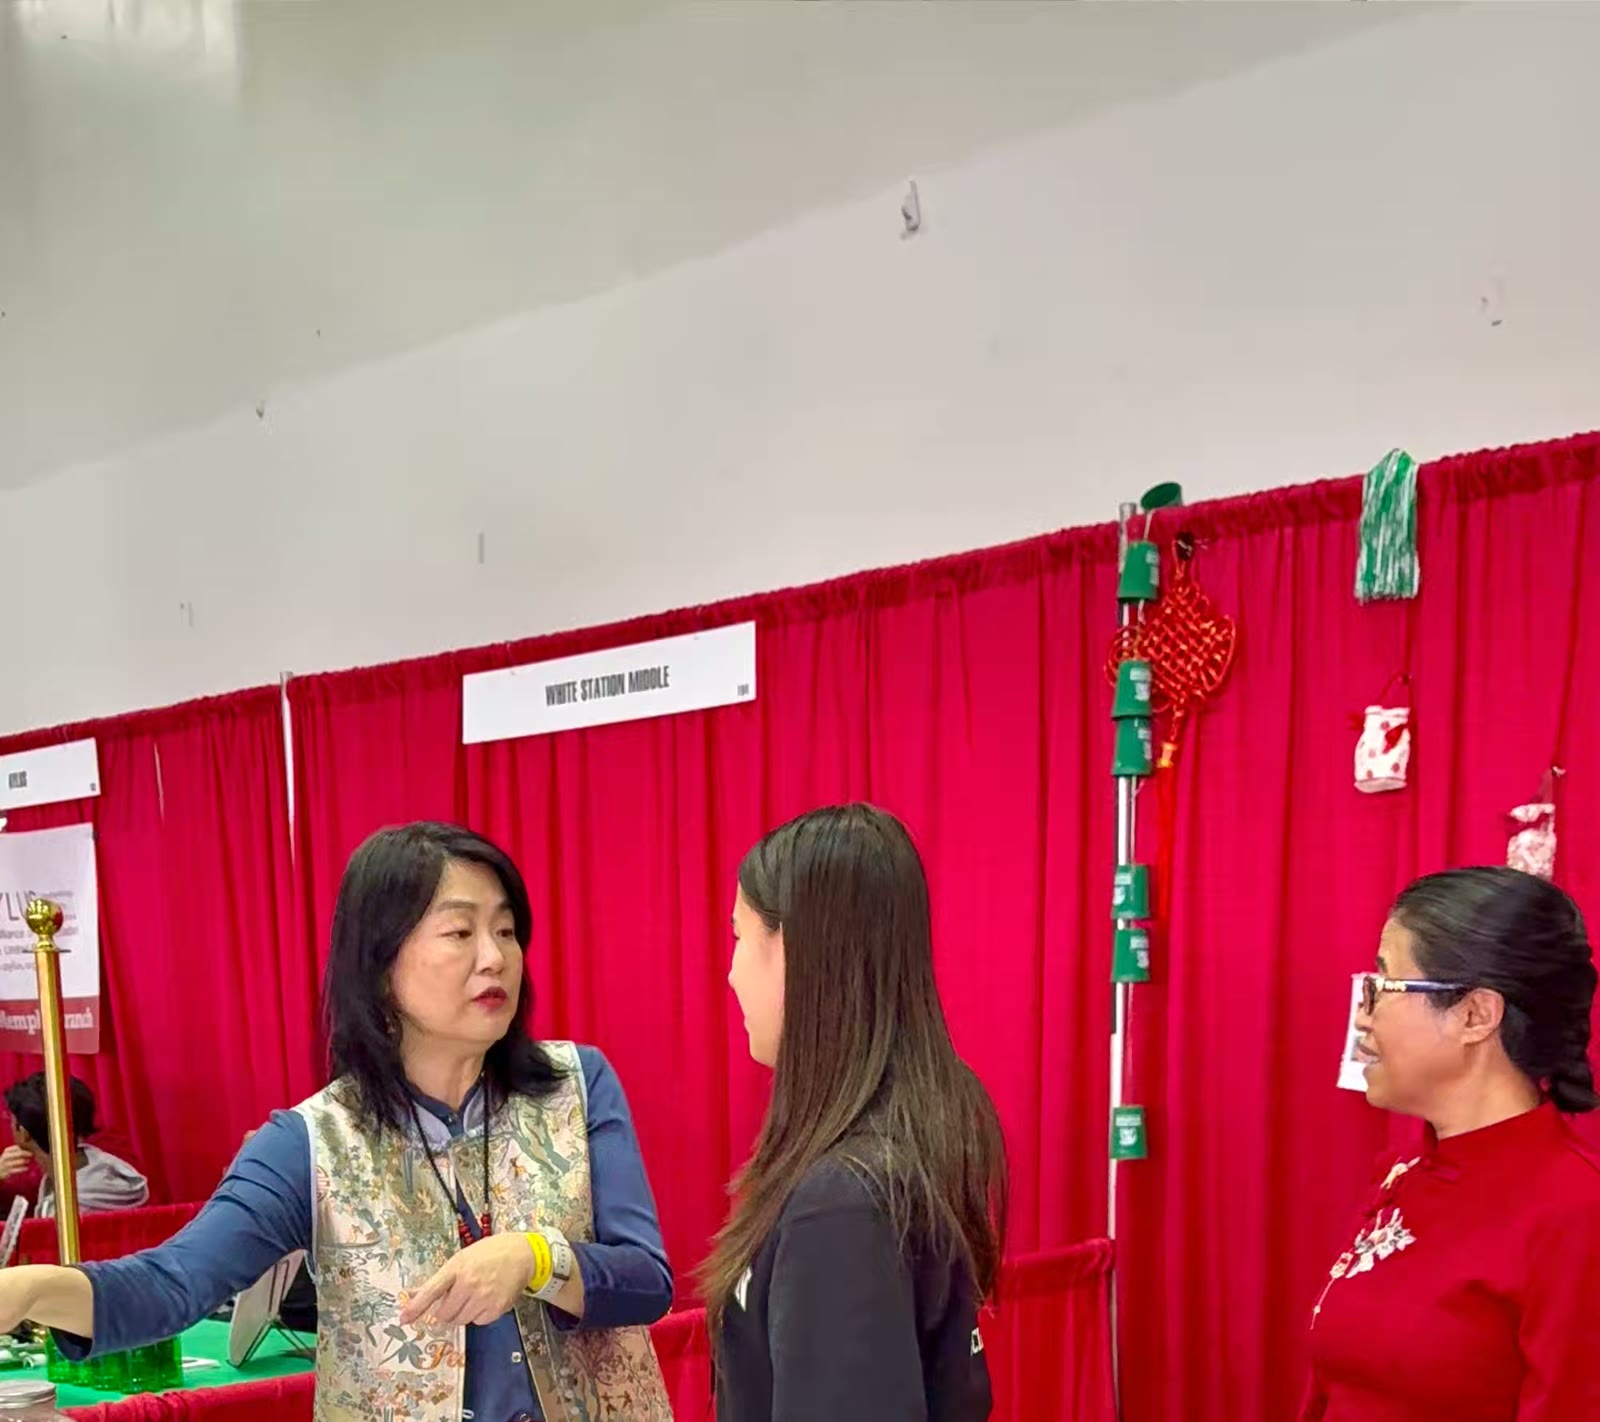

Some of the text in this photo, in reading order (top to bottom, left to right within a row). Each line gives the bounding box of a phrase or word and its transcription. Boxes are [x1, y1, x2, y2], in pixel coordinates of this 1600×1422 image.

[545, 665, 671, 706] WHITE STATION MIDDLE
